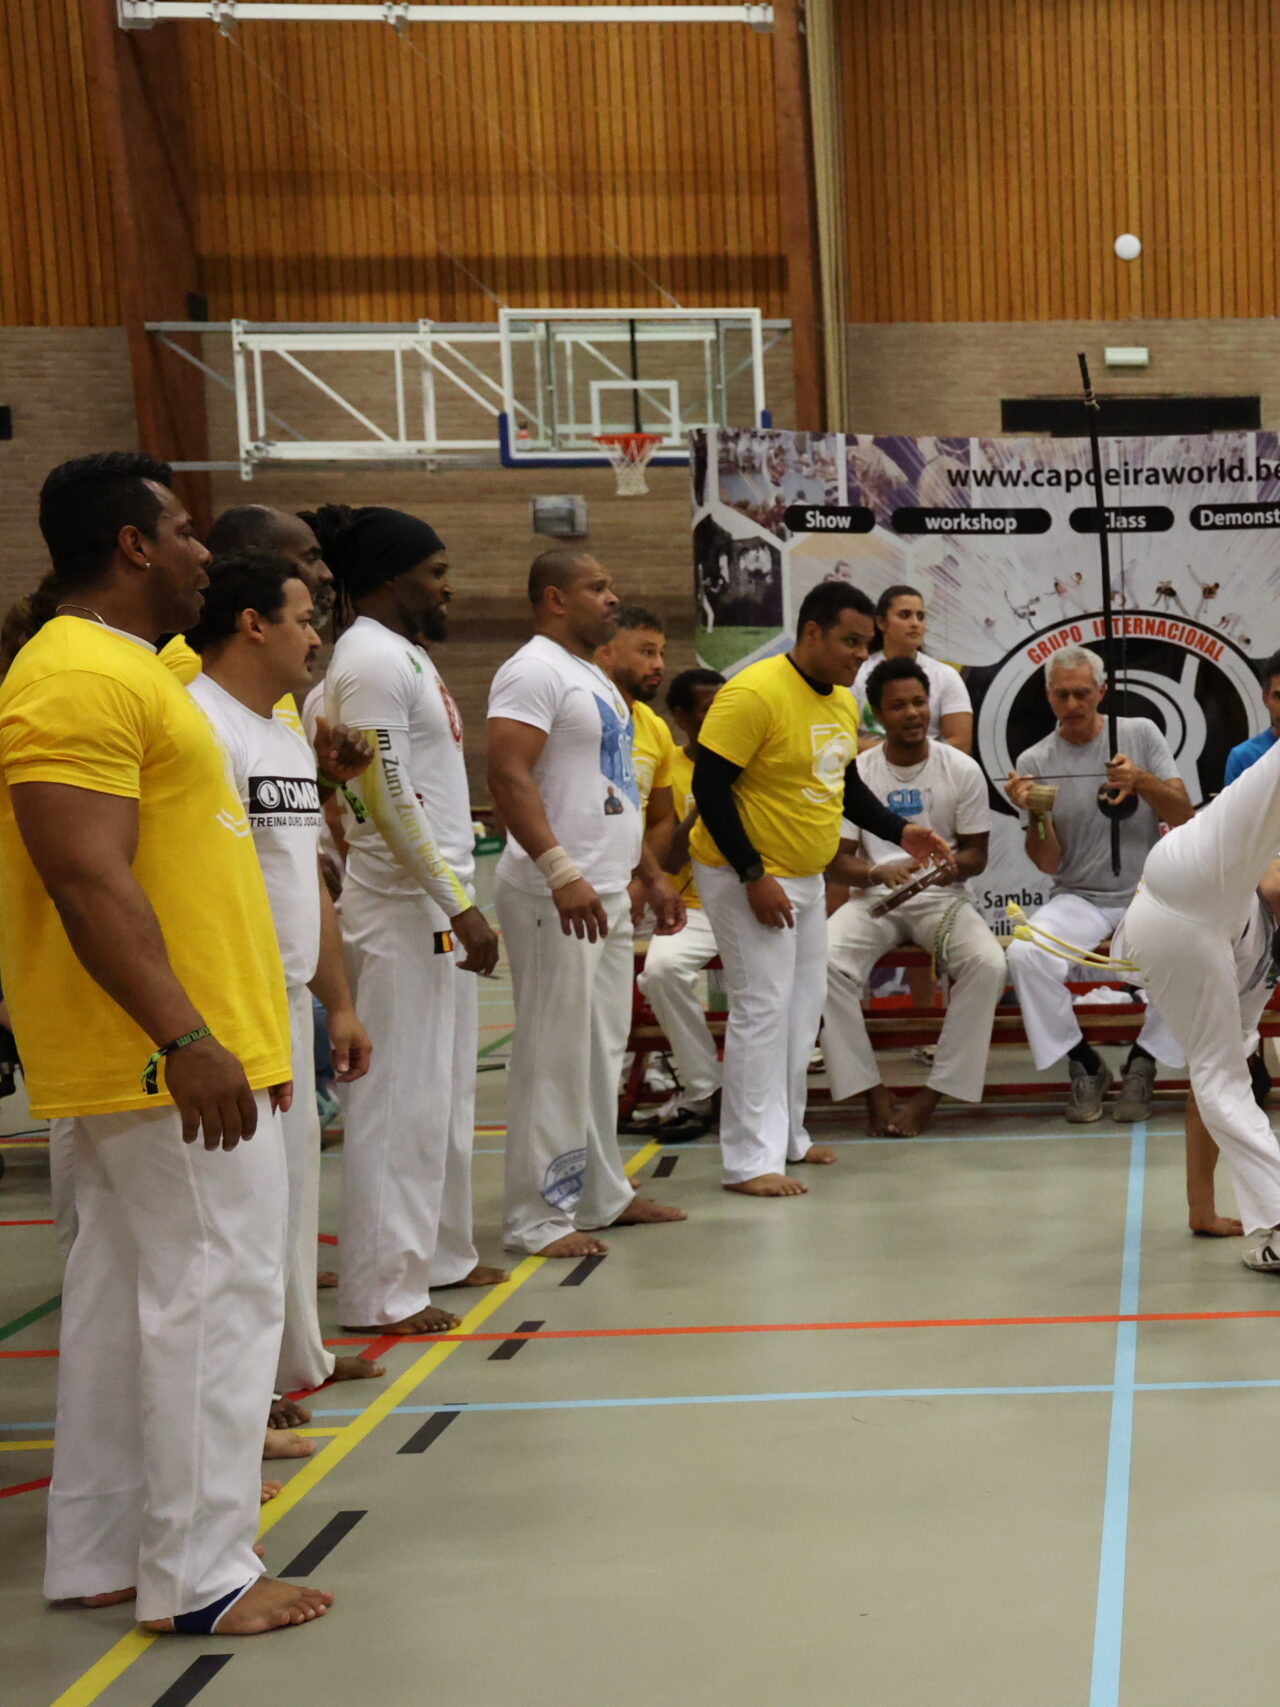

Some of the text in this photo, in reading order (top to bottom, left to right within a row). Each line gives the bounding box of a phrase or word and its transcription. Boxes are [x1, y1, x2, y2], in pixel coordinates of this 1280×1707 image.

[805, 511, 851, 530] Show
[924, 513, 1018, 534] workshop
[1103, 511, 1147, 529] lass
[1027, 625, 1083, 664] GRUPO
[983, 888, 1043, 909] Samba
